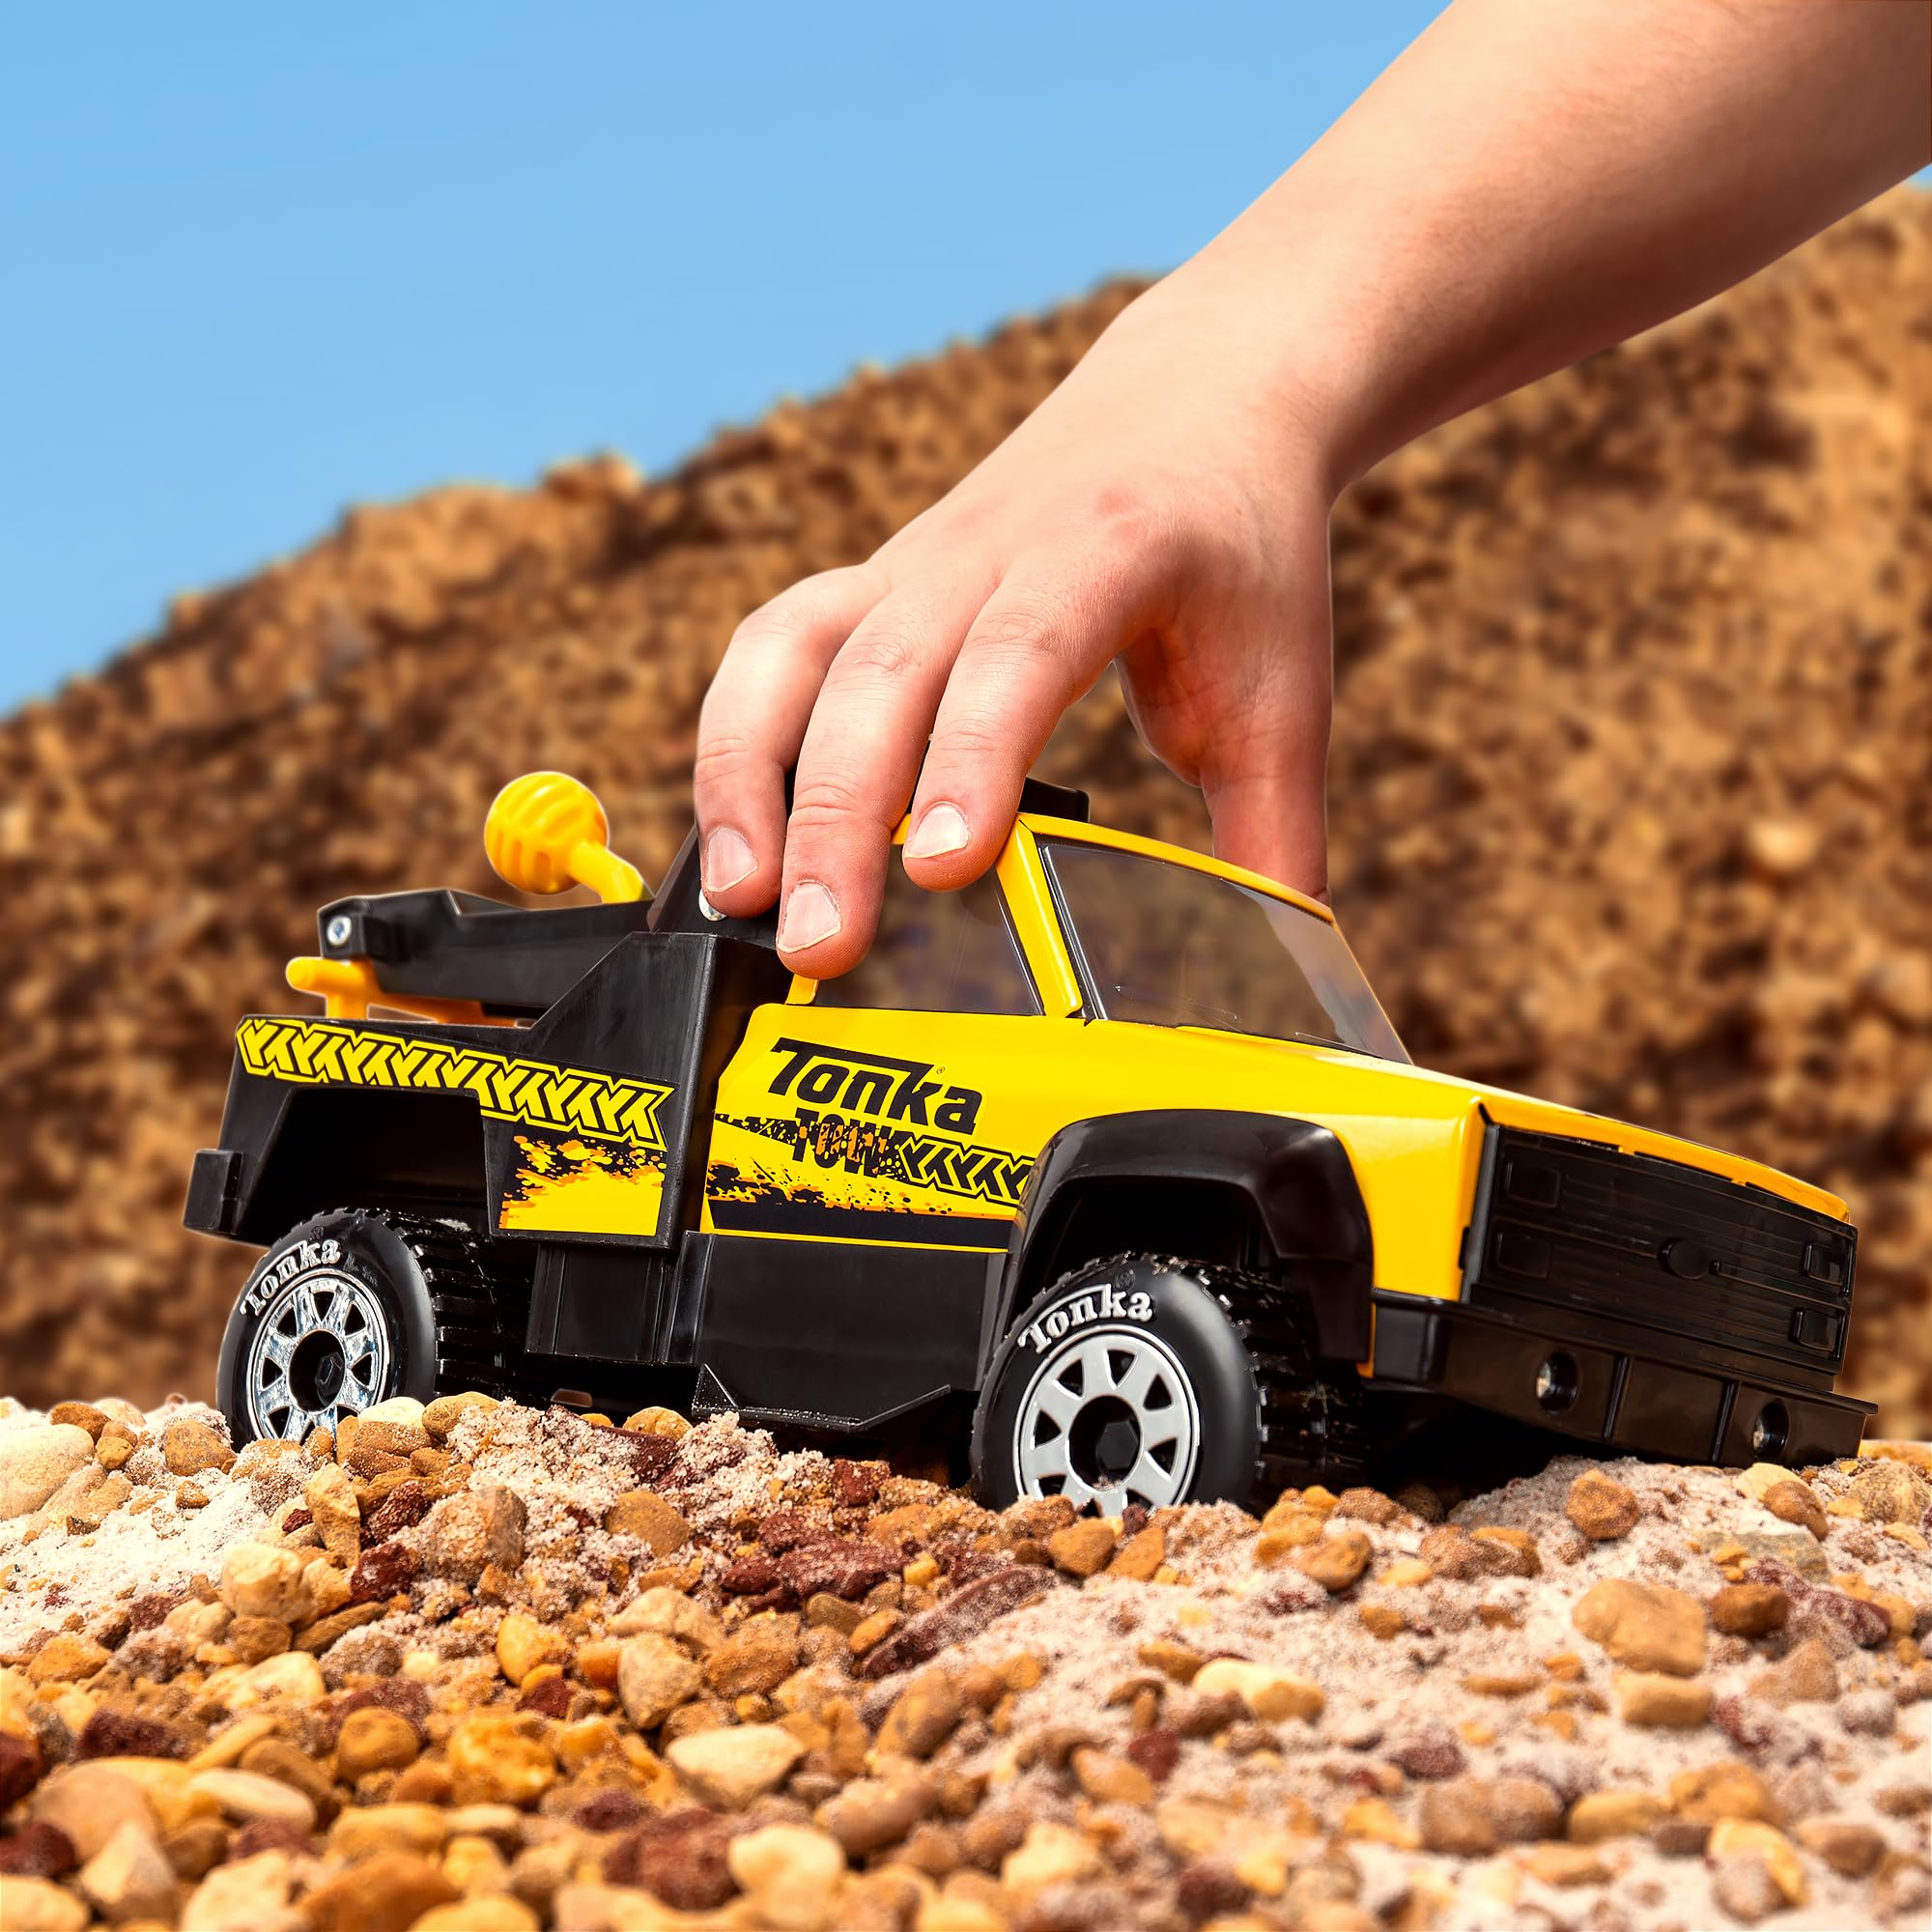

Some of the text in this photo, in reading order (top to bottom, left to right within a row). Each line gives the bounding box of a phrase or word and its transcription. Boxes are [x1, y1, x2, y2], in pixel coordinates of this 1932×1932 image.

[768, 1037, 982, 1135] Tonka
[240, 1239, 341, 1316] Tonka
[1017, 1283, 1153, 1353] Tonka
